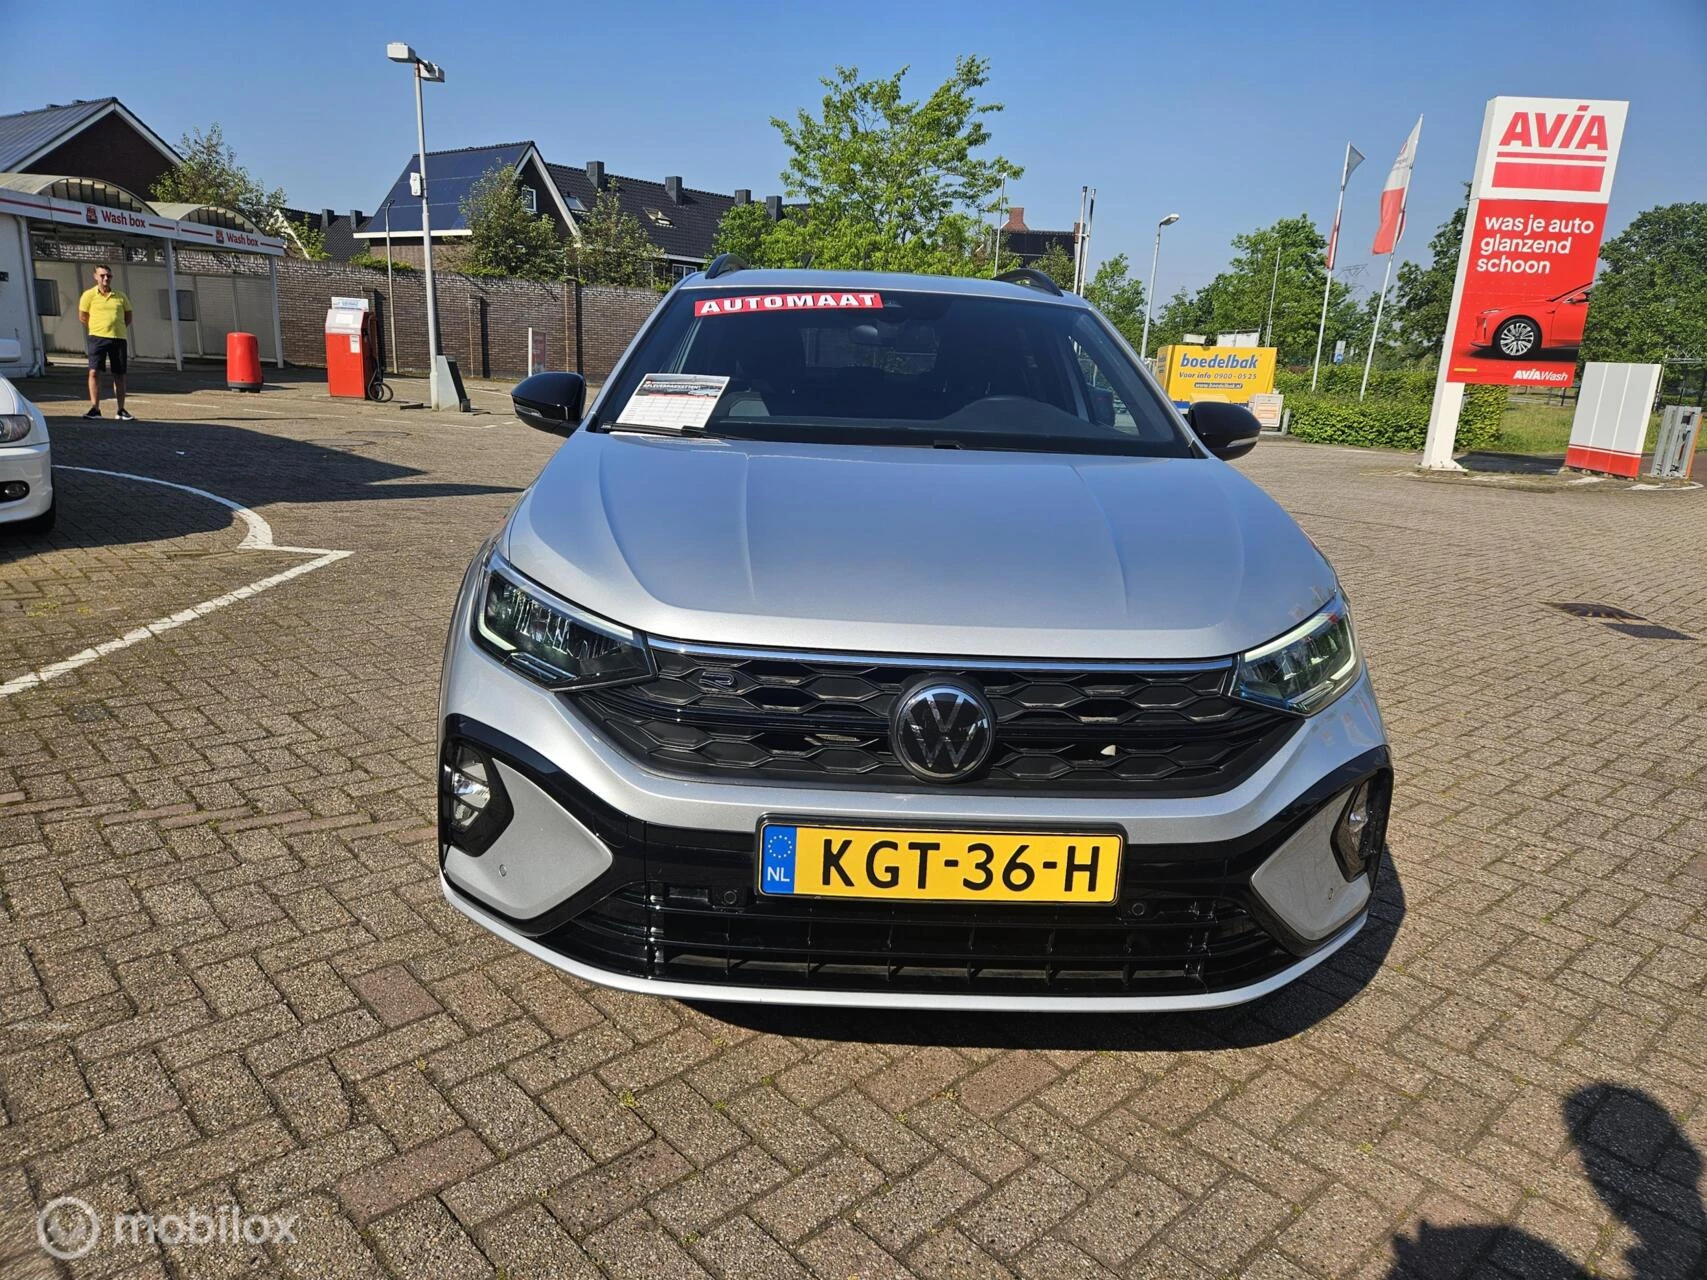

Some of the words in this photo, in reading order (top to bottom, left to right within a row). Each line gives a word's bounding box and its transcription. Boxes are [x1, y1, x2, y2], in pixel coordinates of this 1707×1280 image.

[101, 209, 127, 226] Wash
[129, 213, 146, 228] box
[1484, 216, 1524, 232] was
[1525, 214, 1545, 235] je
[1549, 217, 1595, 234] auto
[225, 232, 246, 246] Wash
[247, 235, 259, 247] box
[1480, 234, 1572, 255] glanzend
[1476, 255, 1551, 274] schoon
[700, 293, 876, 315] AUTOMAAT
[1180, 353, 1259, 369] boedelbak
[1179, 371, 1195, 379] Voor
[767, 865, 790, 883] NL
[821, 838, 1101, 893] KGT-36-H
